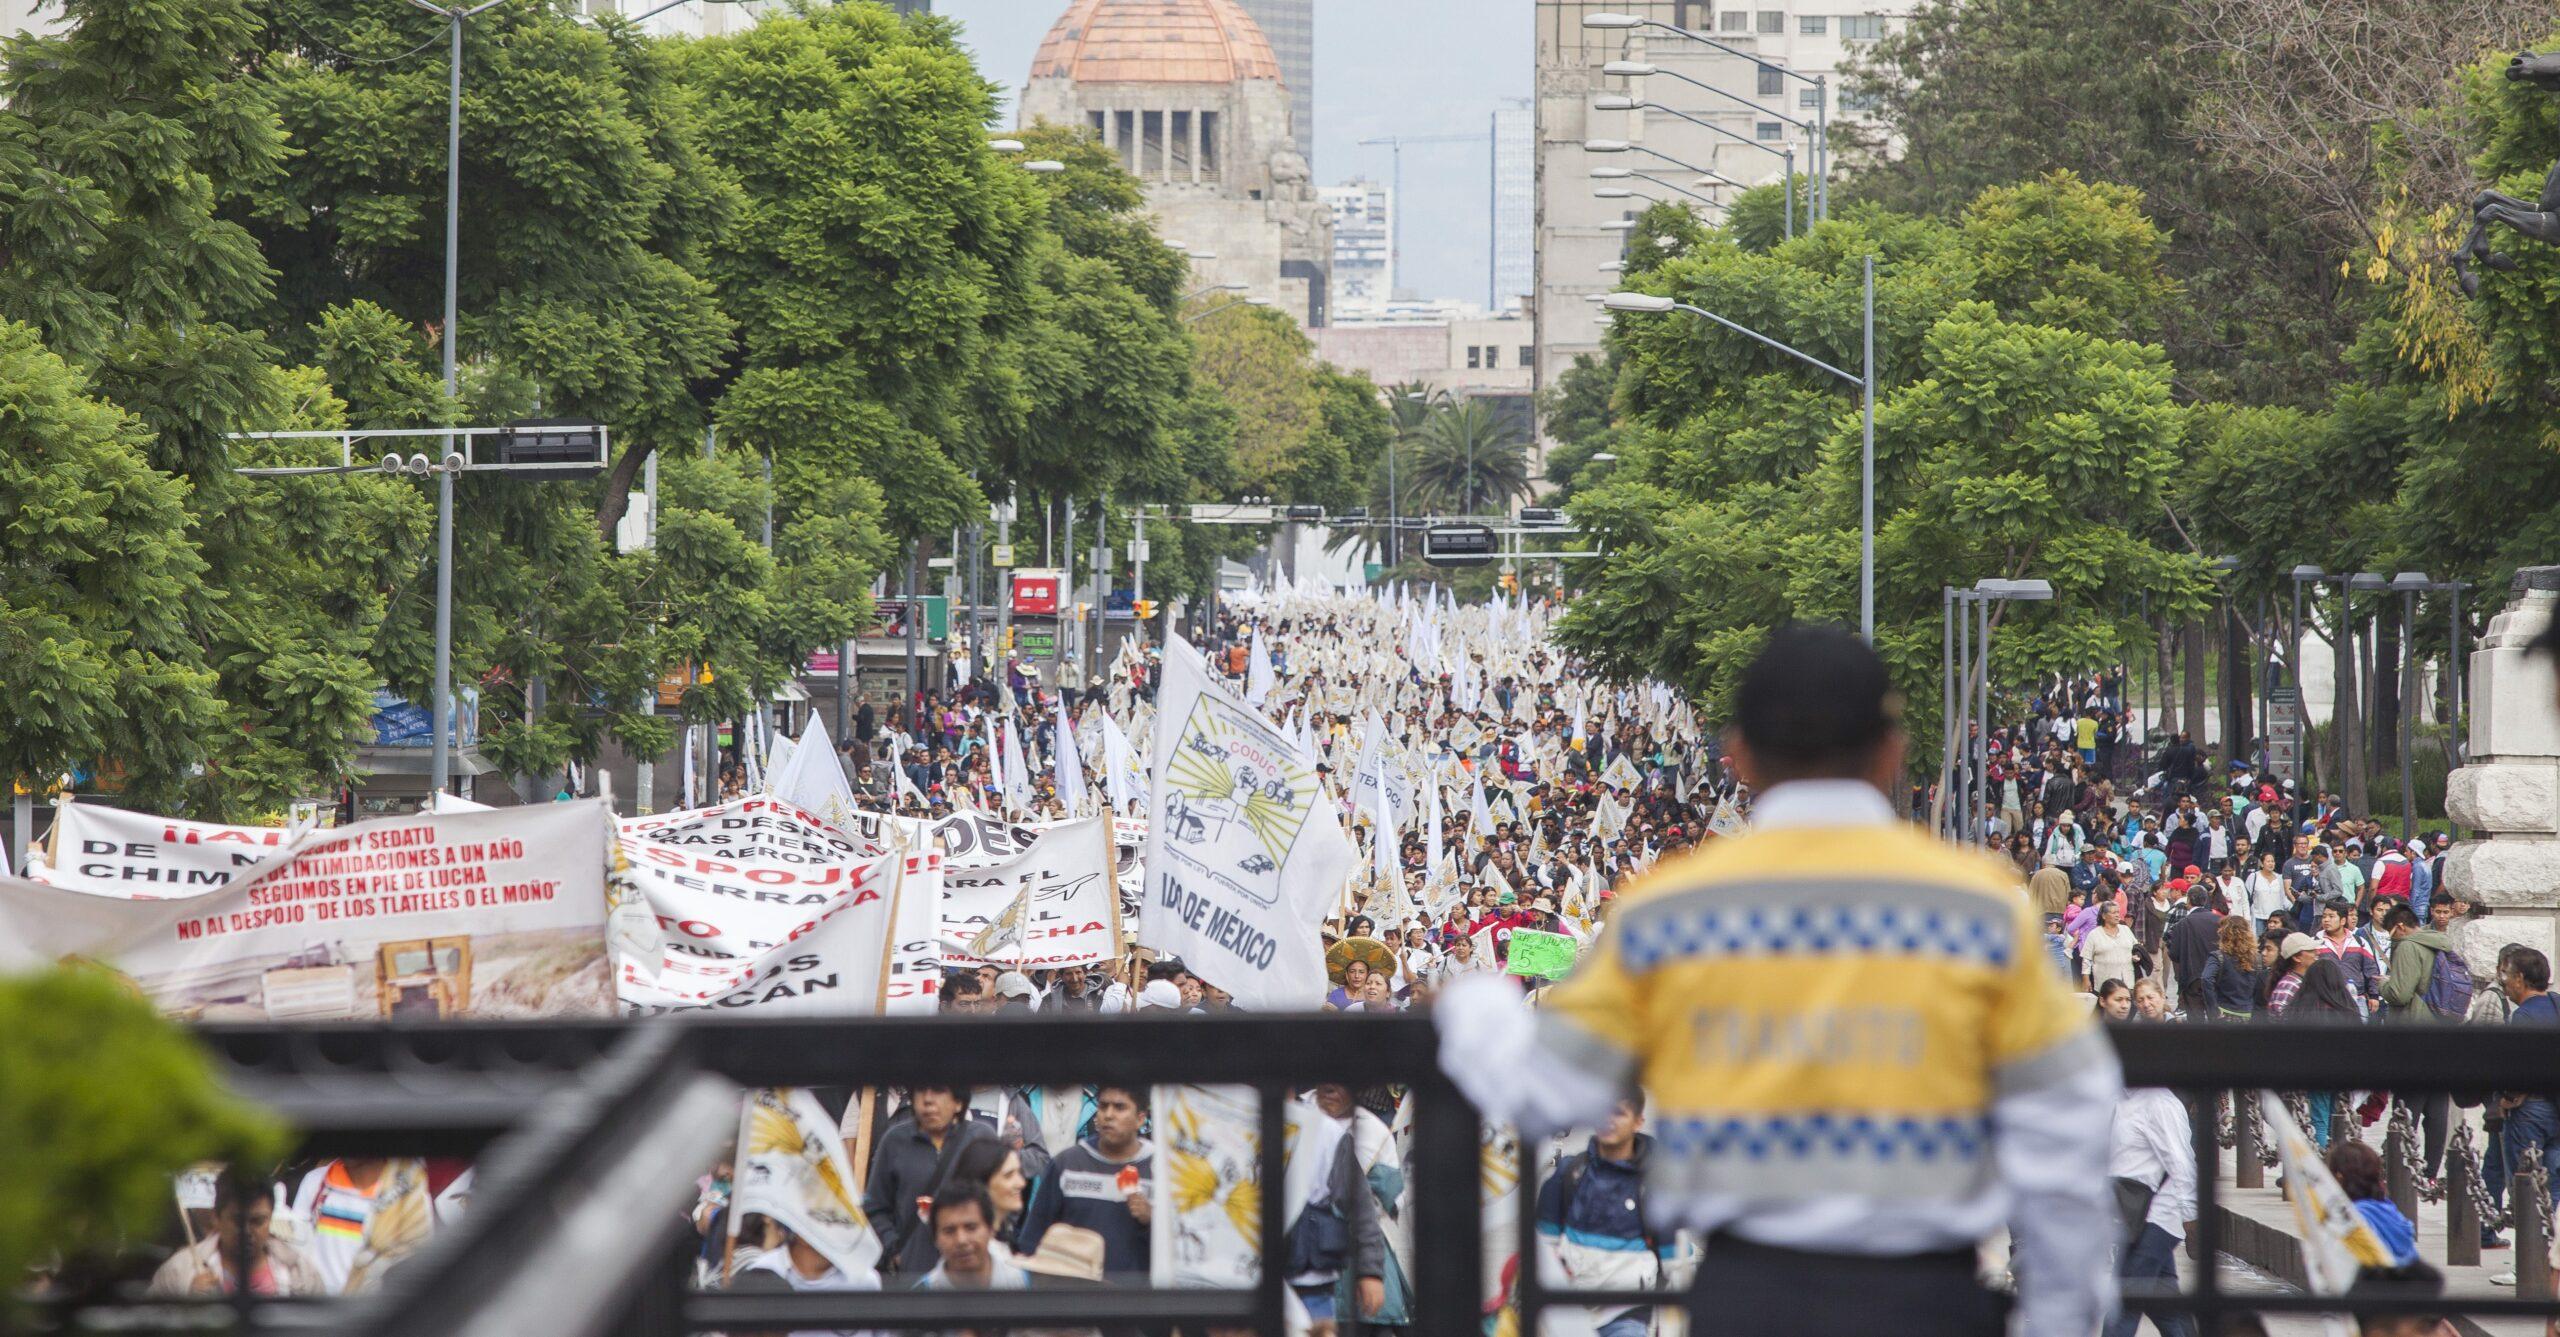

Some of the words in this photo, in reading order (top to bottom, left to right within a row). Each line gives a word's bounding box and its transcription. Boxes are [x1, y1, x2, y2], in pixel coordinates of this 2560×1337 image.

[1230, 741, 1277, 777] CODUC
[1360, 772, 1402, 809] TEXOCO
[82, 840, 157, 859] DE
[355, 834, 364, 851] Y
[369, 826, 435, 851] SEDATU
[293, 848, 441, 879] INTIMIDACIONES
[446, 847, 457, 865] A
[461, 844, 485, 863] UN
[489, 838, 524, 861] AÑO
[248, 879, 342, 906] SEGUIMOS
[347, 877, 367, 896] EN
[373, 873, 399, 894] PIE
[405, 872, 425, 890] DE
[430, 866, 488, 888] LUCHA
[177, 919, 202, 940] NO
[206, 914, 228, 936] AL
[231, 903, 305, 932] DESPOJO
[345, 898, 376, 918] LOS
[381, 891, 460, 915] TLATELES
[465, 888, 476, 907] O
[482, 887, 498, 905] EL
[1183, 891, 1211, 932] DE
[1205, 908, 1277, 971] MÉXICO
